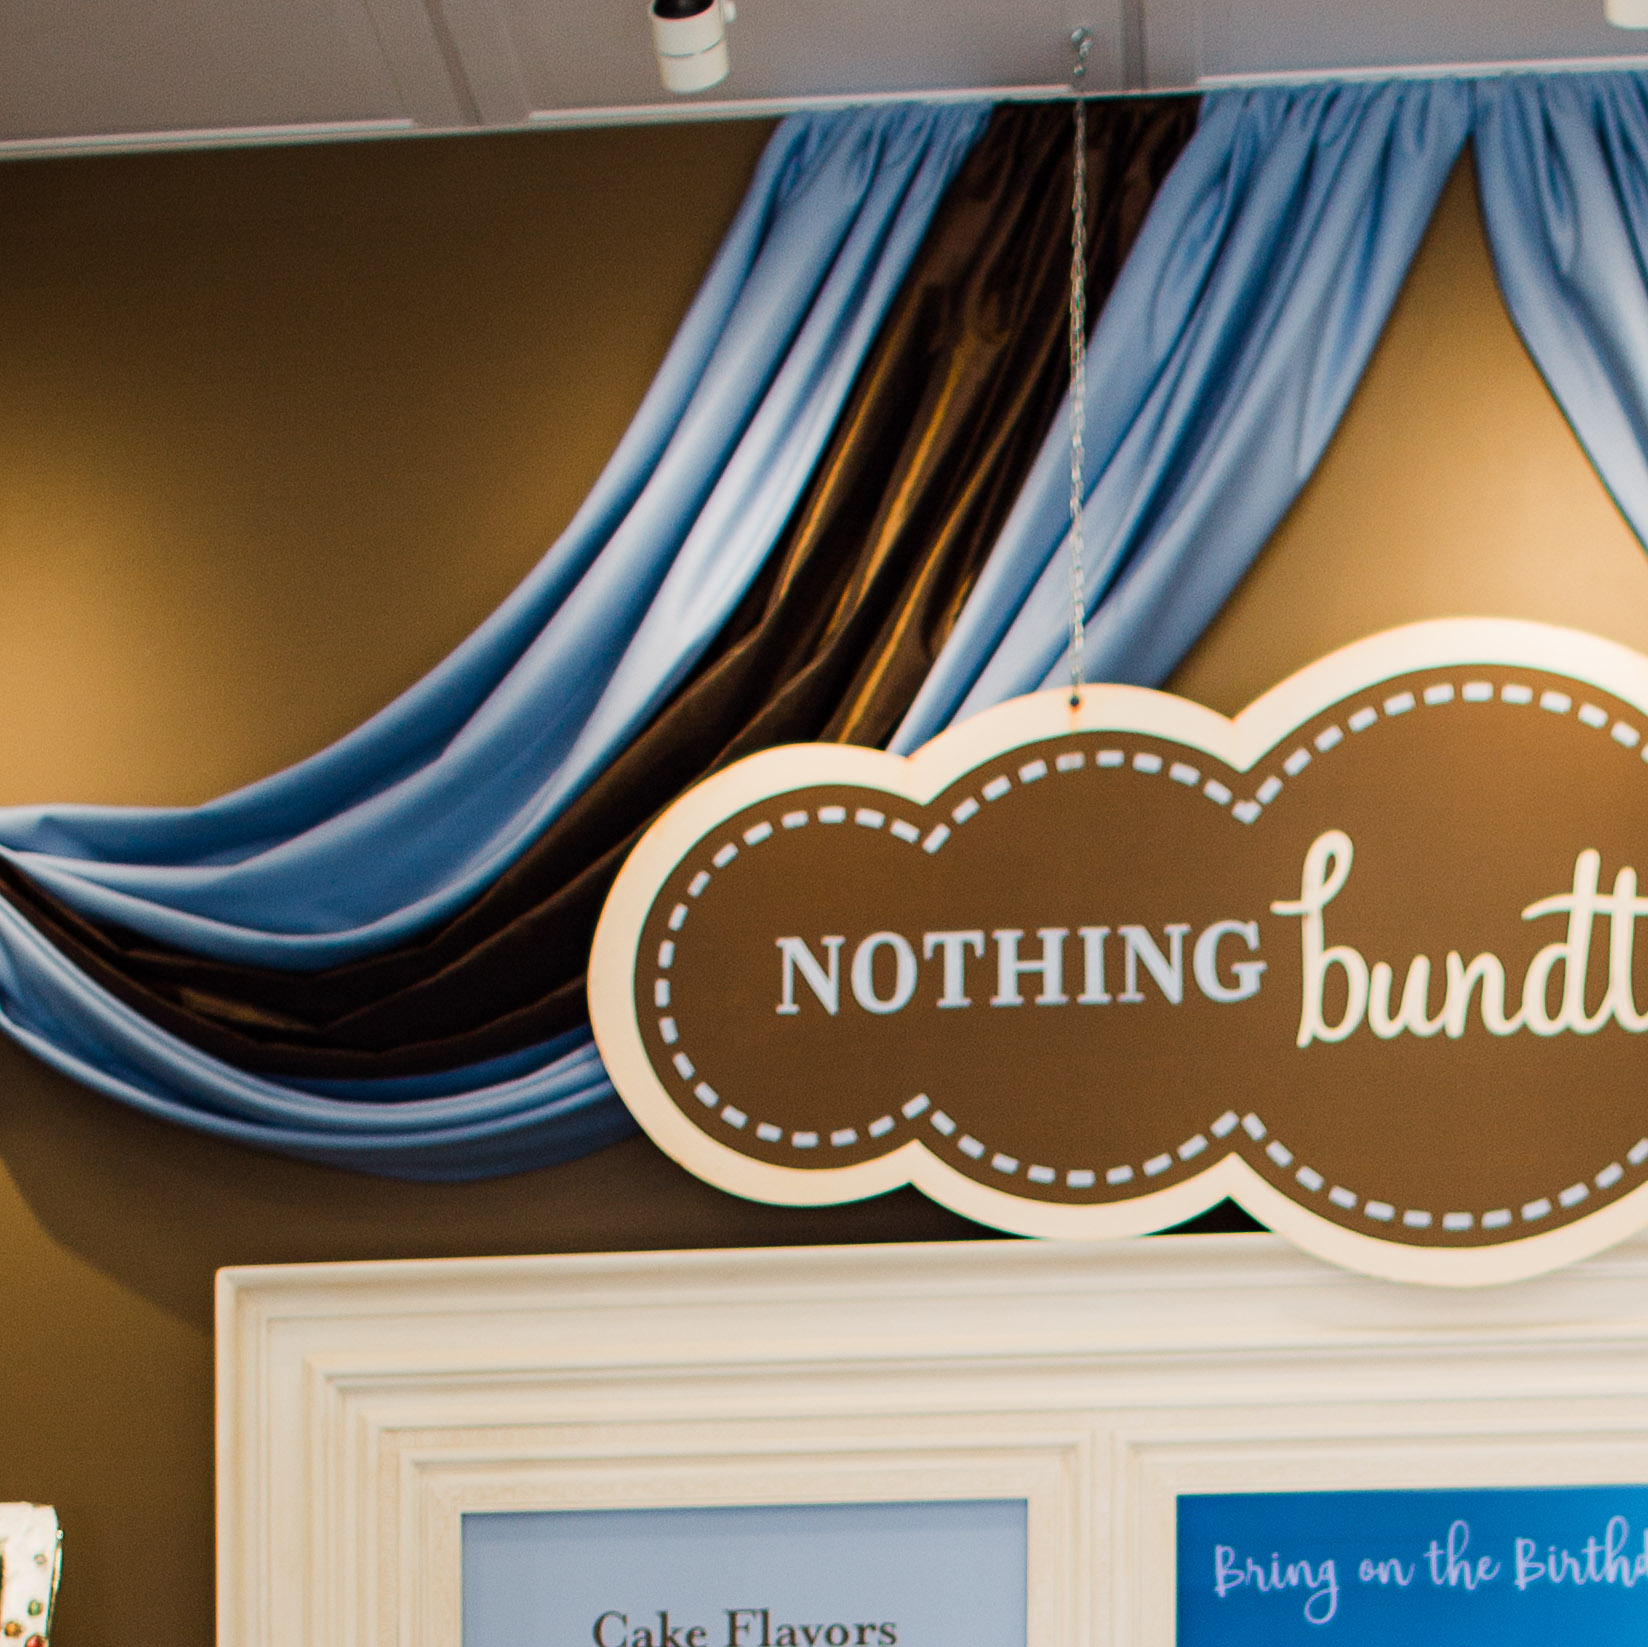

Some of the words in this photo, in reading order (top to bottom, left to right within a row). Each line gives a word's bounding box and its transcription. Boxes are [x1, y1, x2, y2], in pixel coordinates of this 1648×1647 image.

[775, 917, 1267, 1016] NOTHING
[1214, 1544, 1339, 1625] Bring
[1359, 1557, 1415, 1586] on
[1424, 1519, 1500, 1590] the
